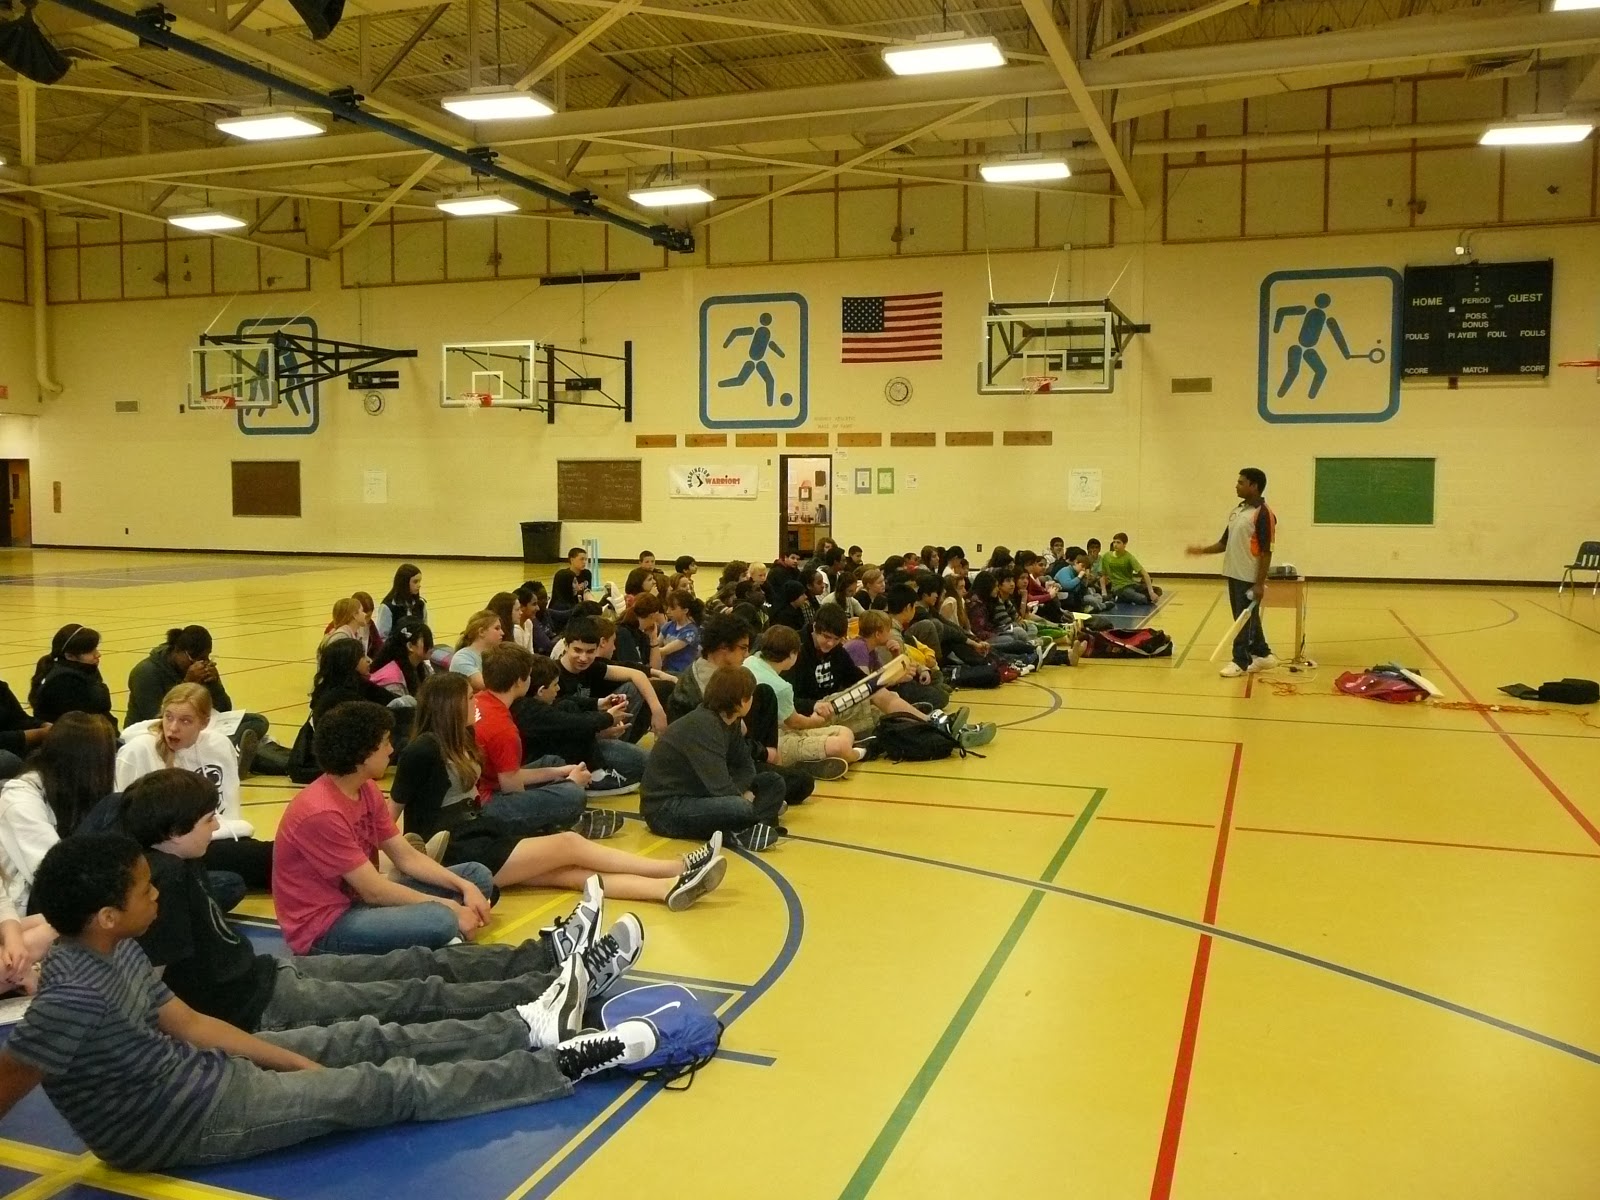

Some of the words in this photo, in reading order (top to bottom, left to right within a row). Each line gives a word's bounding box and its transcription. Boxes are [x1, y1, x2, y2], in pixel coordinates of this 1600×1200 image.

[1412, 296, 1443, 306] HOME
[1508, 293, 1543, 303] GUEST
[687, 467, 710, 488] WASHINGTON
